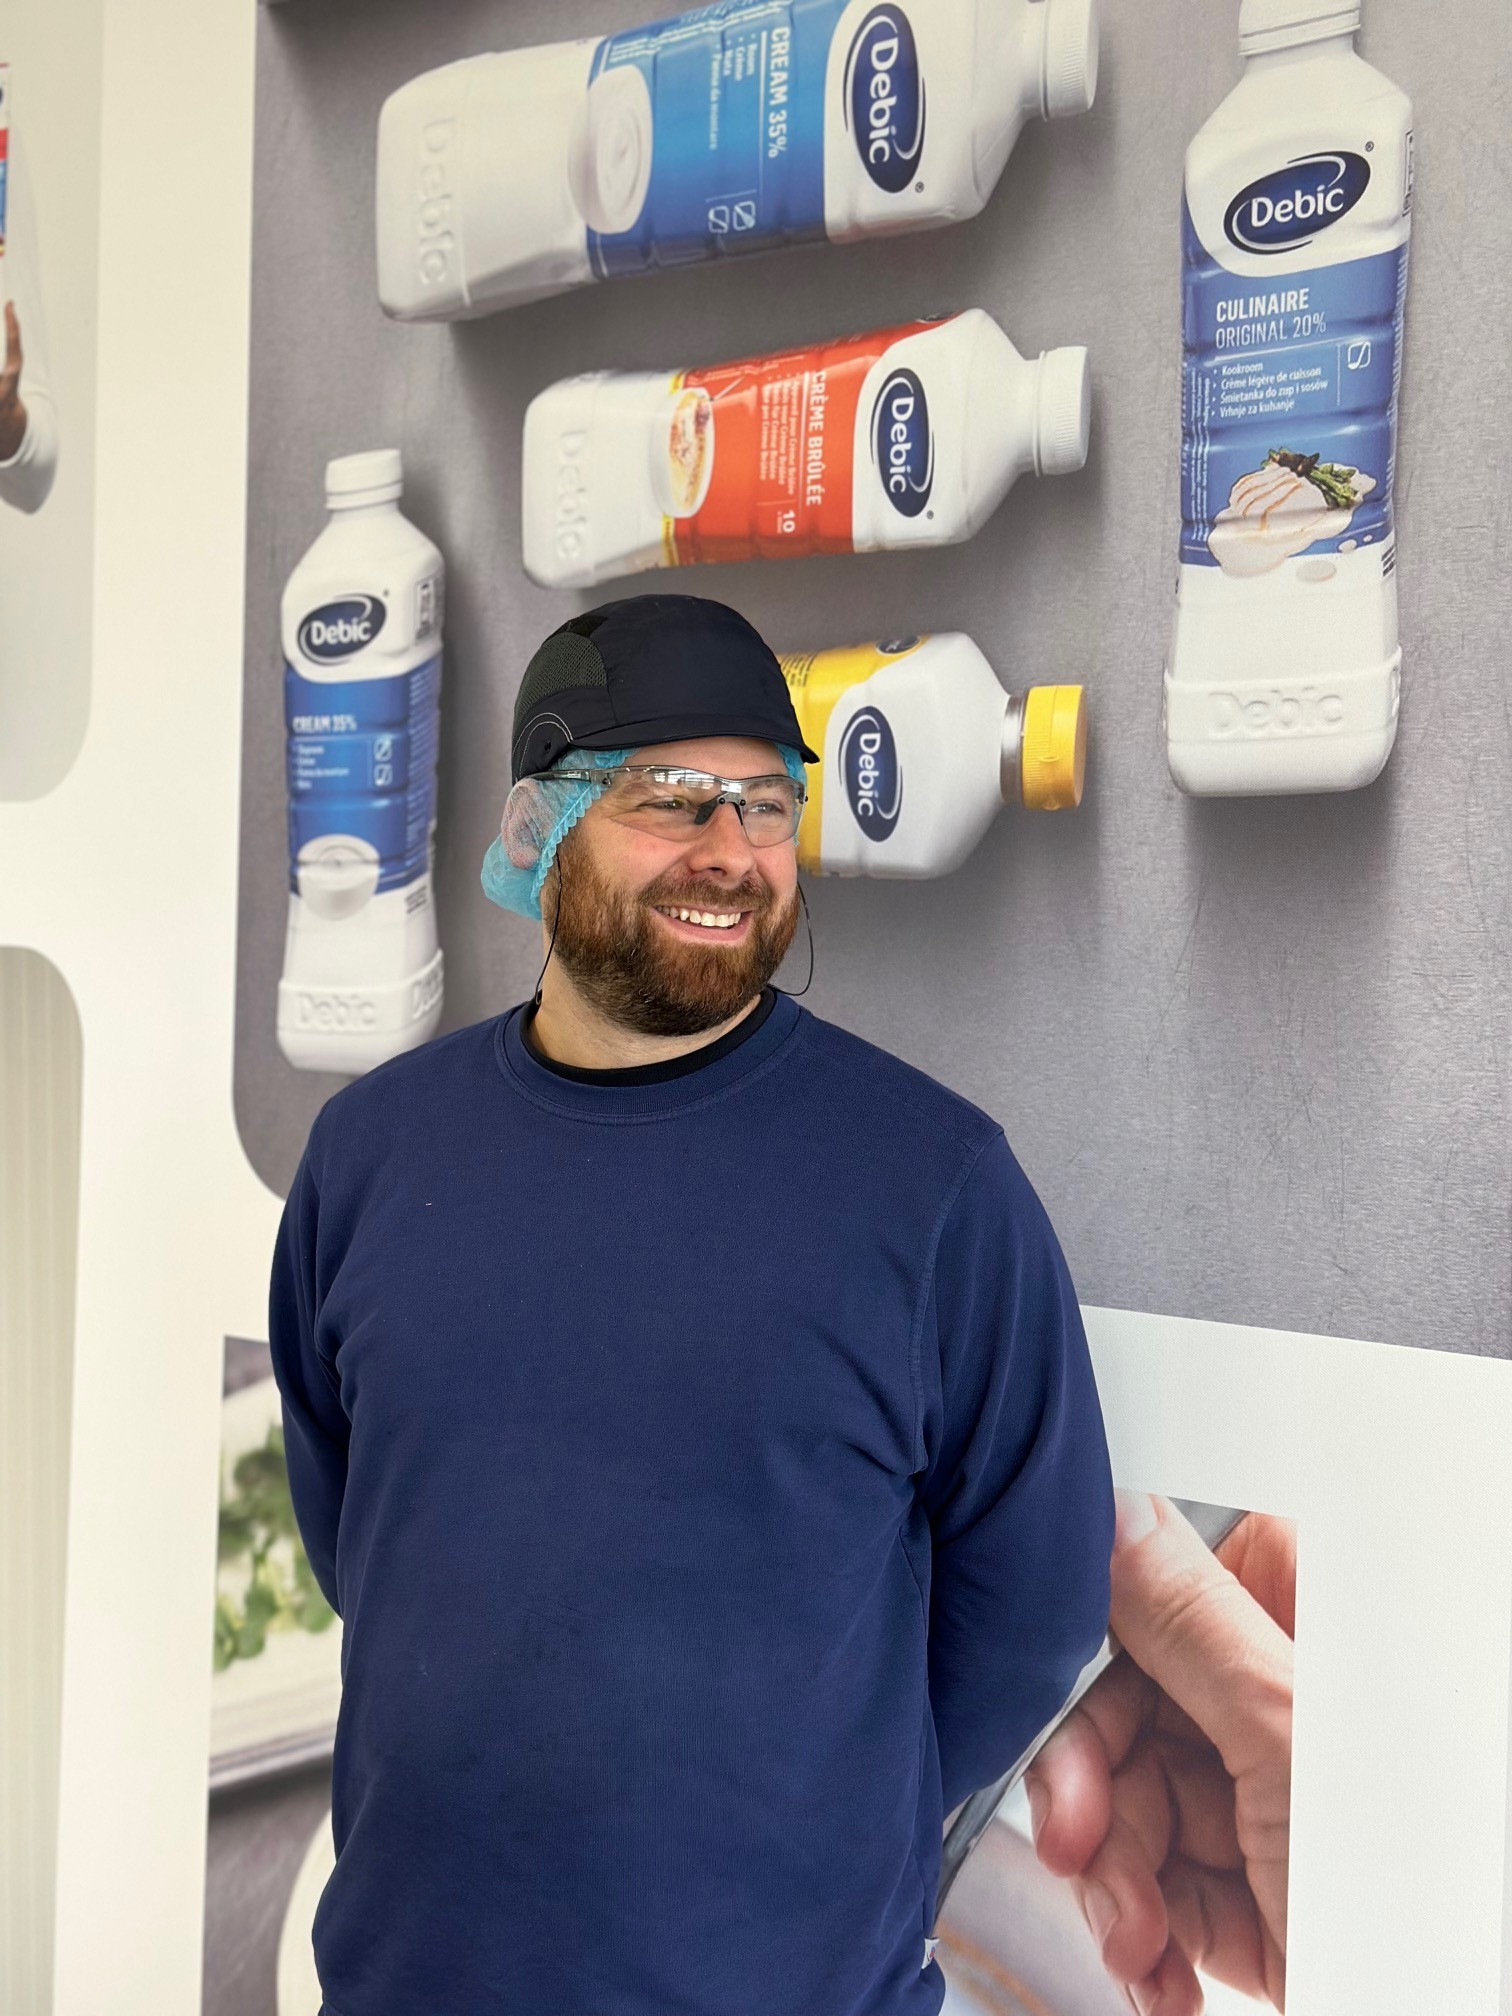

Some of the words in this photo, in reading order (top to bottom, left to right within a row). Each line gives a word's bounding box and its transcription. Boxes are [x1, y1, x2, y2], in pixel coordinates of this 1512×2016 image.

[769, 27, 791, 105] CREAM
[868, 37, 899, 164] Debic
[768, 109, 788, 158] 35%
[1250, 184, 1344, 228] Debic
[1216, 288, 1310, 322] CULINAIRE
[1216, 320, 1287, 349] ORIGINAL
[1293, 313, 1327, 338] 20%
[1221, 378, 1247, 390] Crème
[1276, 371, 1288, 381] de
[1289, 367, 1322, 380] cuisson
[1222, 363, 1263, 376] Kookroom
[809, 371, 829, 432] CRÈME
[1220, 406, 1247, 418] Vrhnje
[1247, 405, 1257, 414] za
[1258, 399, 1295, 412] kuhanje
[1265, 386, 1277, 398] do
[1278, 385, 1294, 397] zup
[889, 395, 914, 494] Debic
[806, 436, 826, 506] BRÛLÉE
[782, 510, 795, 533] 10
[311, 617, 371, 646] Debic
[857, 732, 882, 817] Debic
